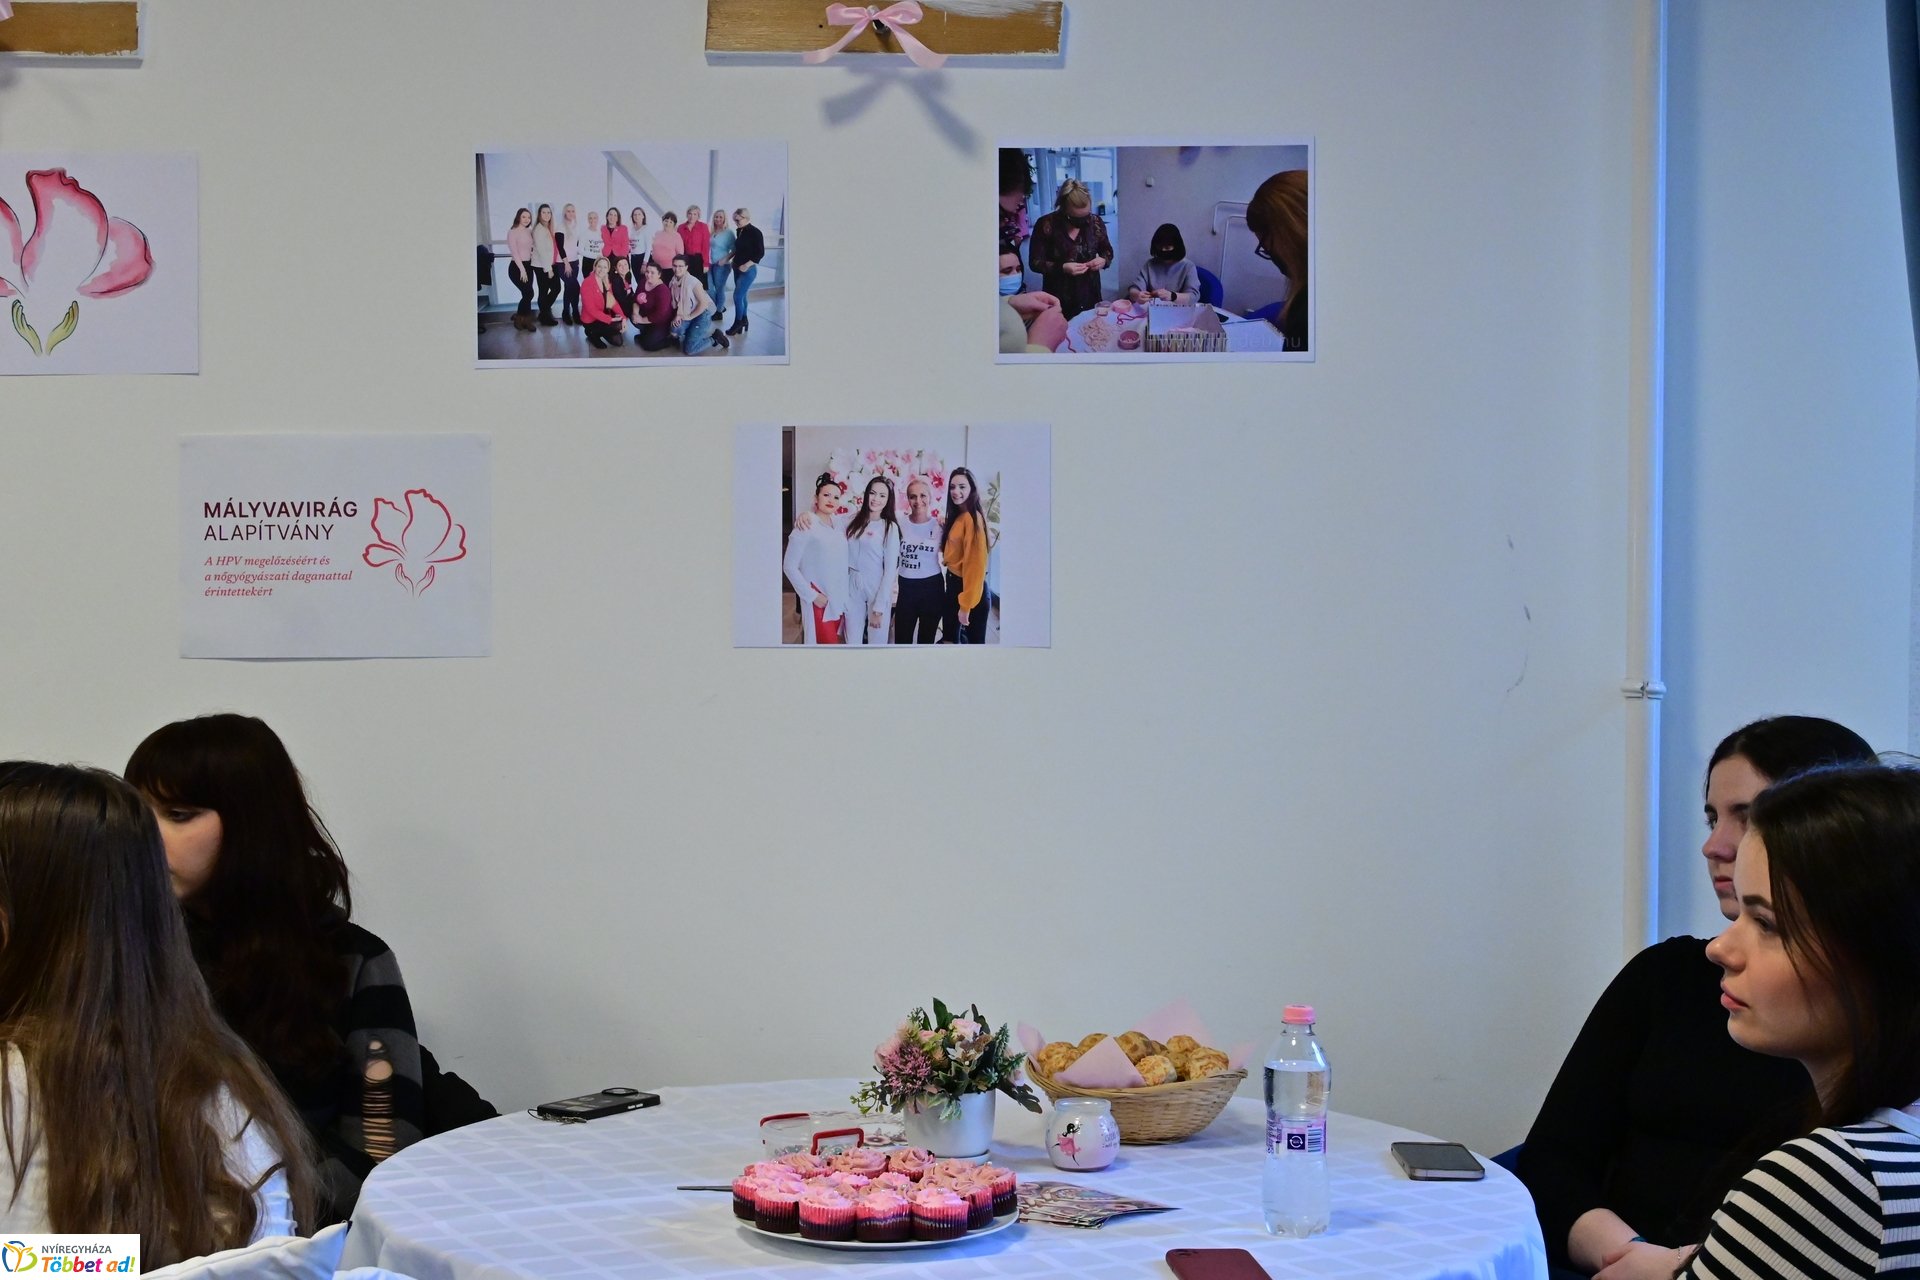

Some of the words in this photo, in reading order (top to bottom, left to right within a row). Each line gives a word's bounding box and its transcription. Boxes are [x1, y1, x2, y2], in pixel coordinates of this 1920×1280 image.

[204, 497, 358, 518] MÁLYVAVIRÁG
[204, 520, 334, 541] ALAPÍTVÁNY
[204, 556, 213, 566] A
[216, 556, 243, 566] HPV
[244, 555, 317, 568] megelőzéséért
[319, 555, 330, 566] és
[214, 570, 289, 584] nőgyógyászati
[291, 570, 353, 584] daganattal
[204, 586, 273, 597] érintettekért
